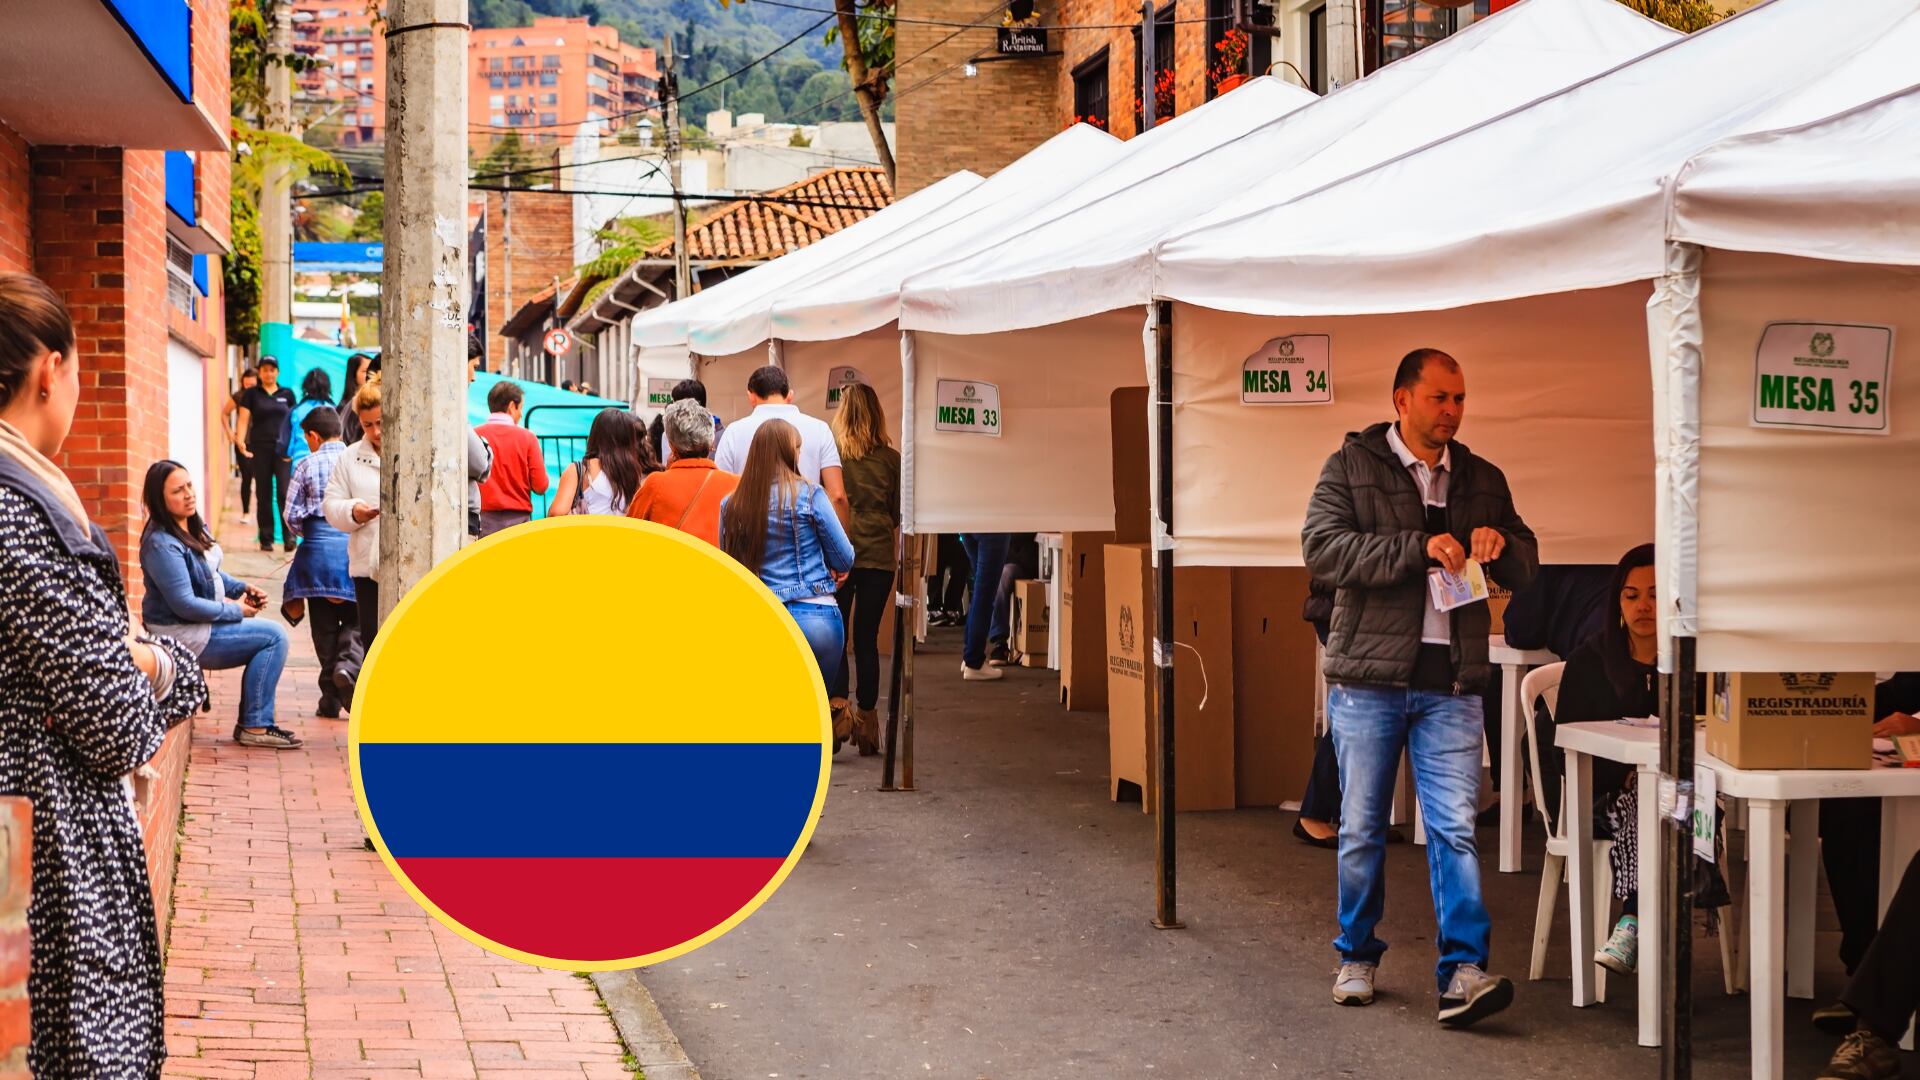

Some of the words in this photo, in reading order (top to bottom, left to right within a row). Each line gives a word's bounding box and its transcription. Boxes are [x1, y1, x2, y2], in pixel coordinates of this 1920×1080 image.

[1002, 40, 1044, 52] Restaurant
[1011, 32, 1037, 45] British
[1244, 369, 1291, 393] MESA
[1306, 370, 1326, 393] 34
[649, 393, 673, 404] MESA
[1760, 374, 1835, 412] MESA
[1848, 379, 1879, 414] 35
[938, 406, 975, 425] MESA
[982, 408, 997, 427] 33
[1747, 694, 1867, 709] REGISTRADURÍA
